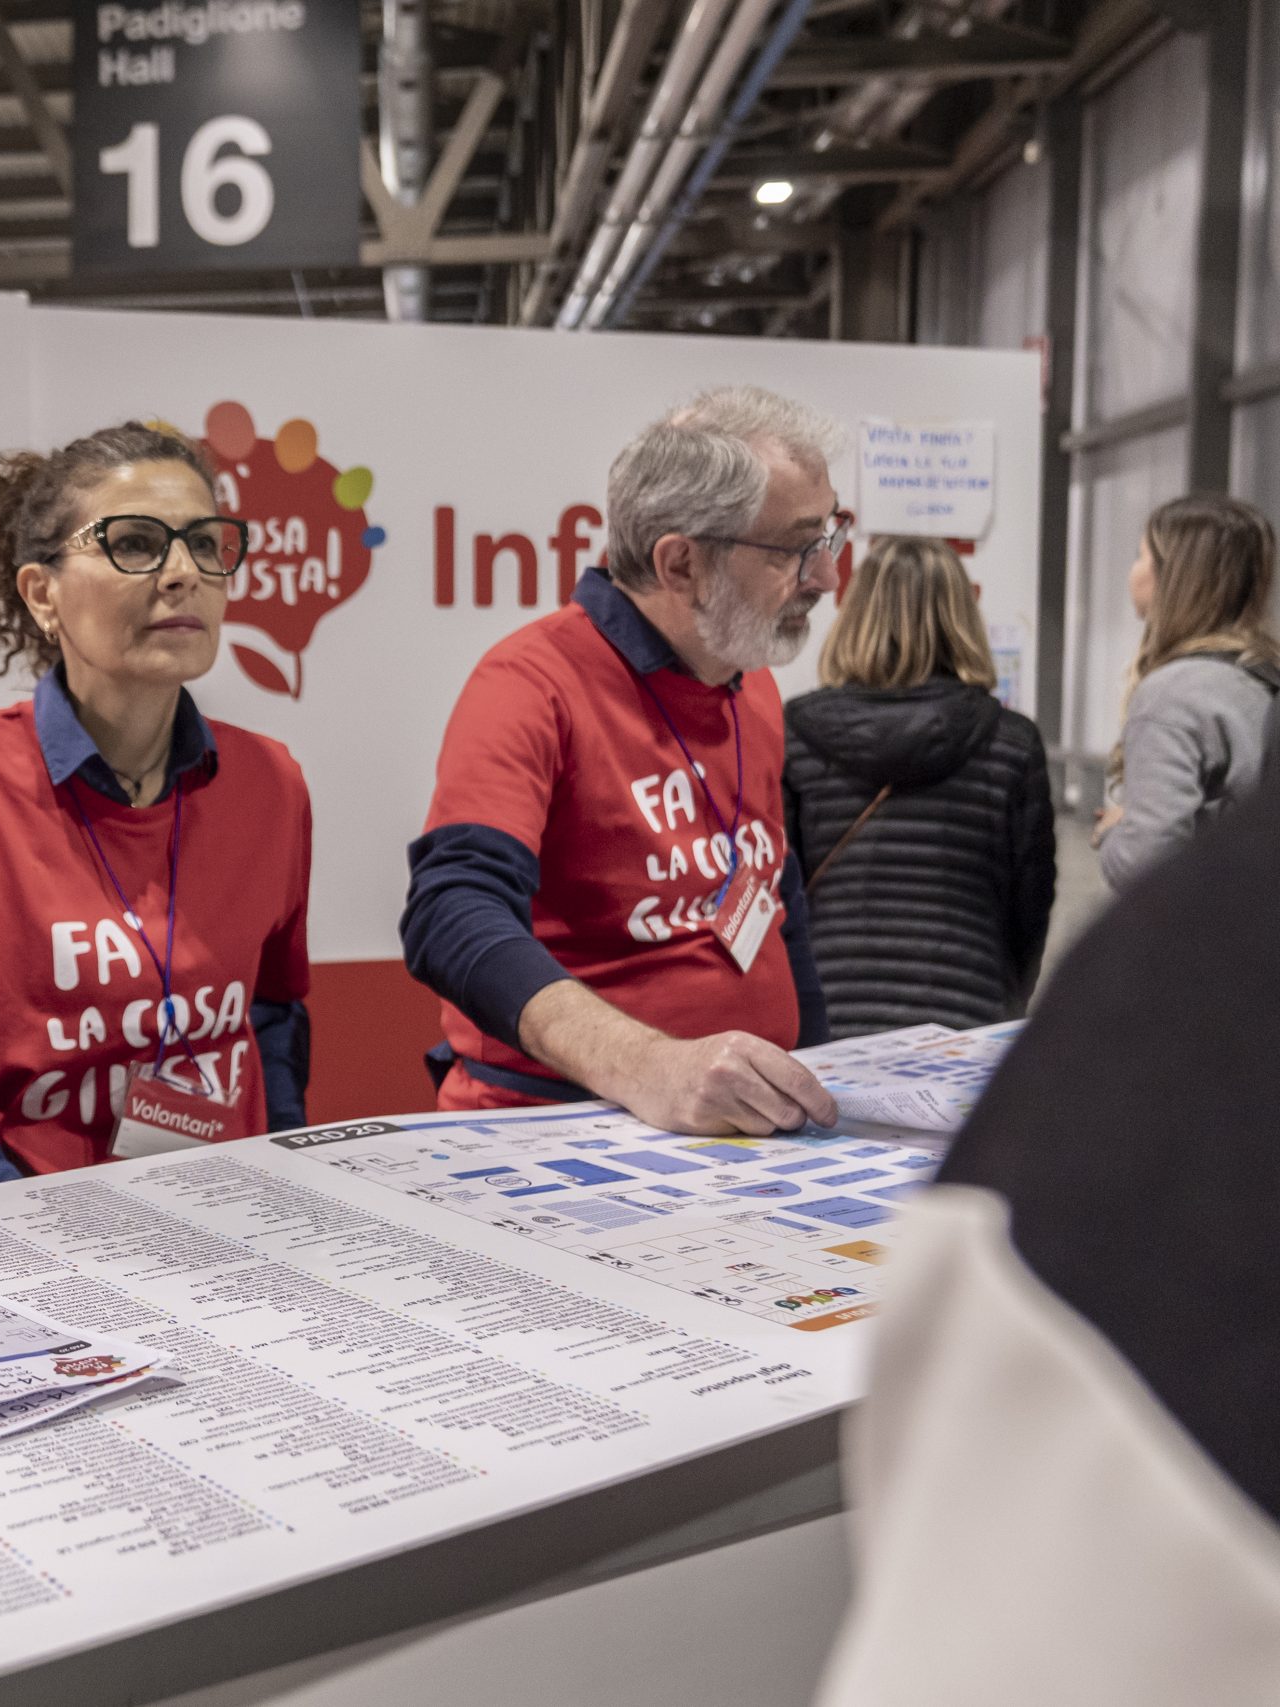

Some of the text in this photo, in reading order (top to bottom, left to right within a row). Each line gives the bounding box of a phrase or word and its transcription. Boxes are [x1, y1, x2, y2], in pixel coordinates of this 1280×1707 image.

[97, 0, 306, 45] Padiglione
[98, 47, 176, 87] Hall
[99, 115, 275, 248] 16
[247, 516, 308, 556] OSA
[434, 504, 608, 608] Inf
[646, 819, 775, 881] LA COSA
[46, 980, 246, 1051] LA COSA
[288, 1123, 386, 1147] PAD 20
[9, 1389, 77, 1413] 14-16
